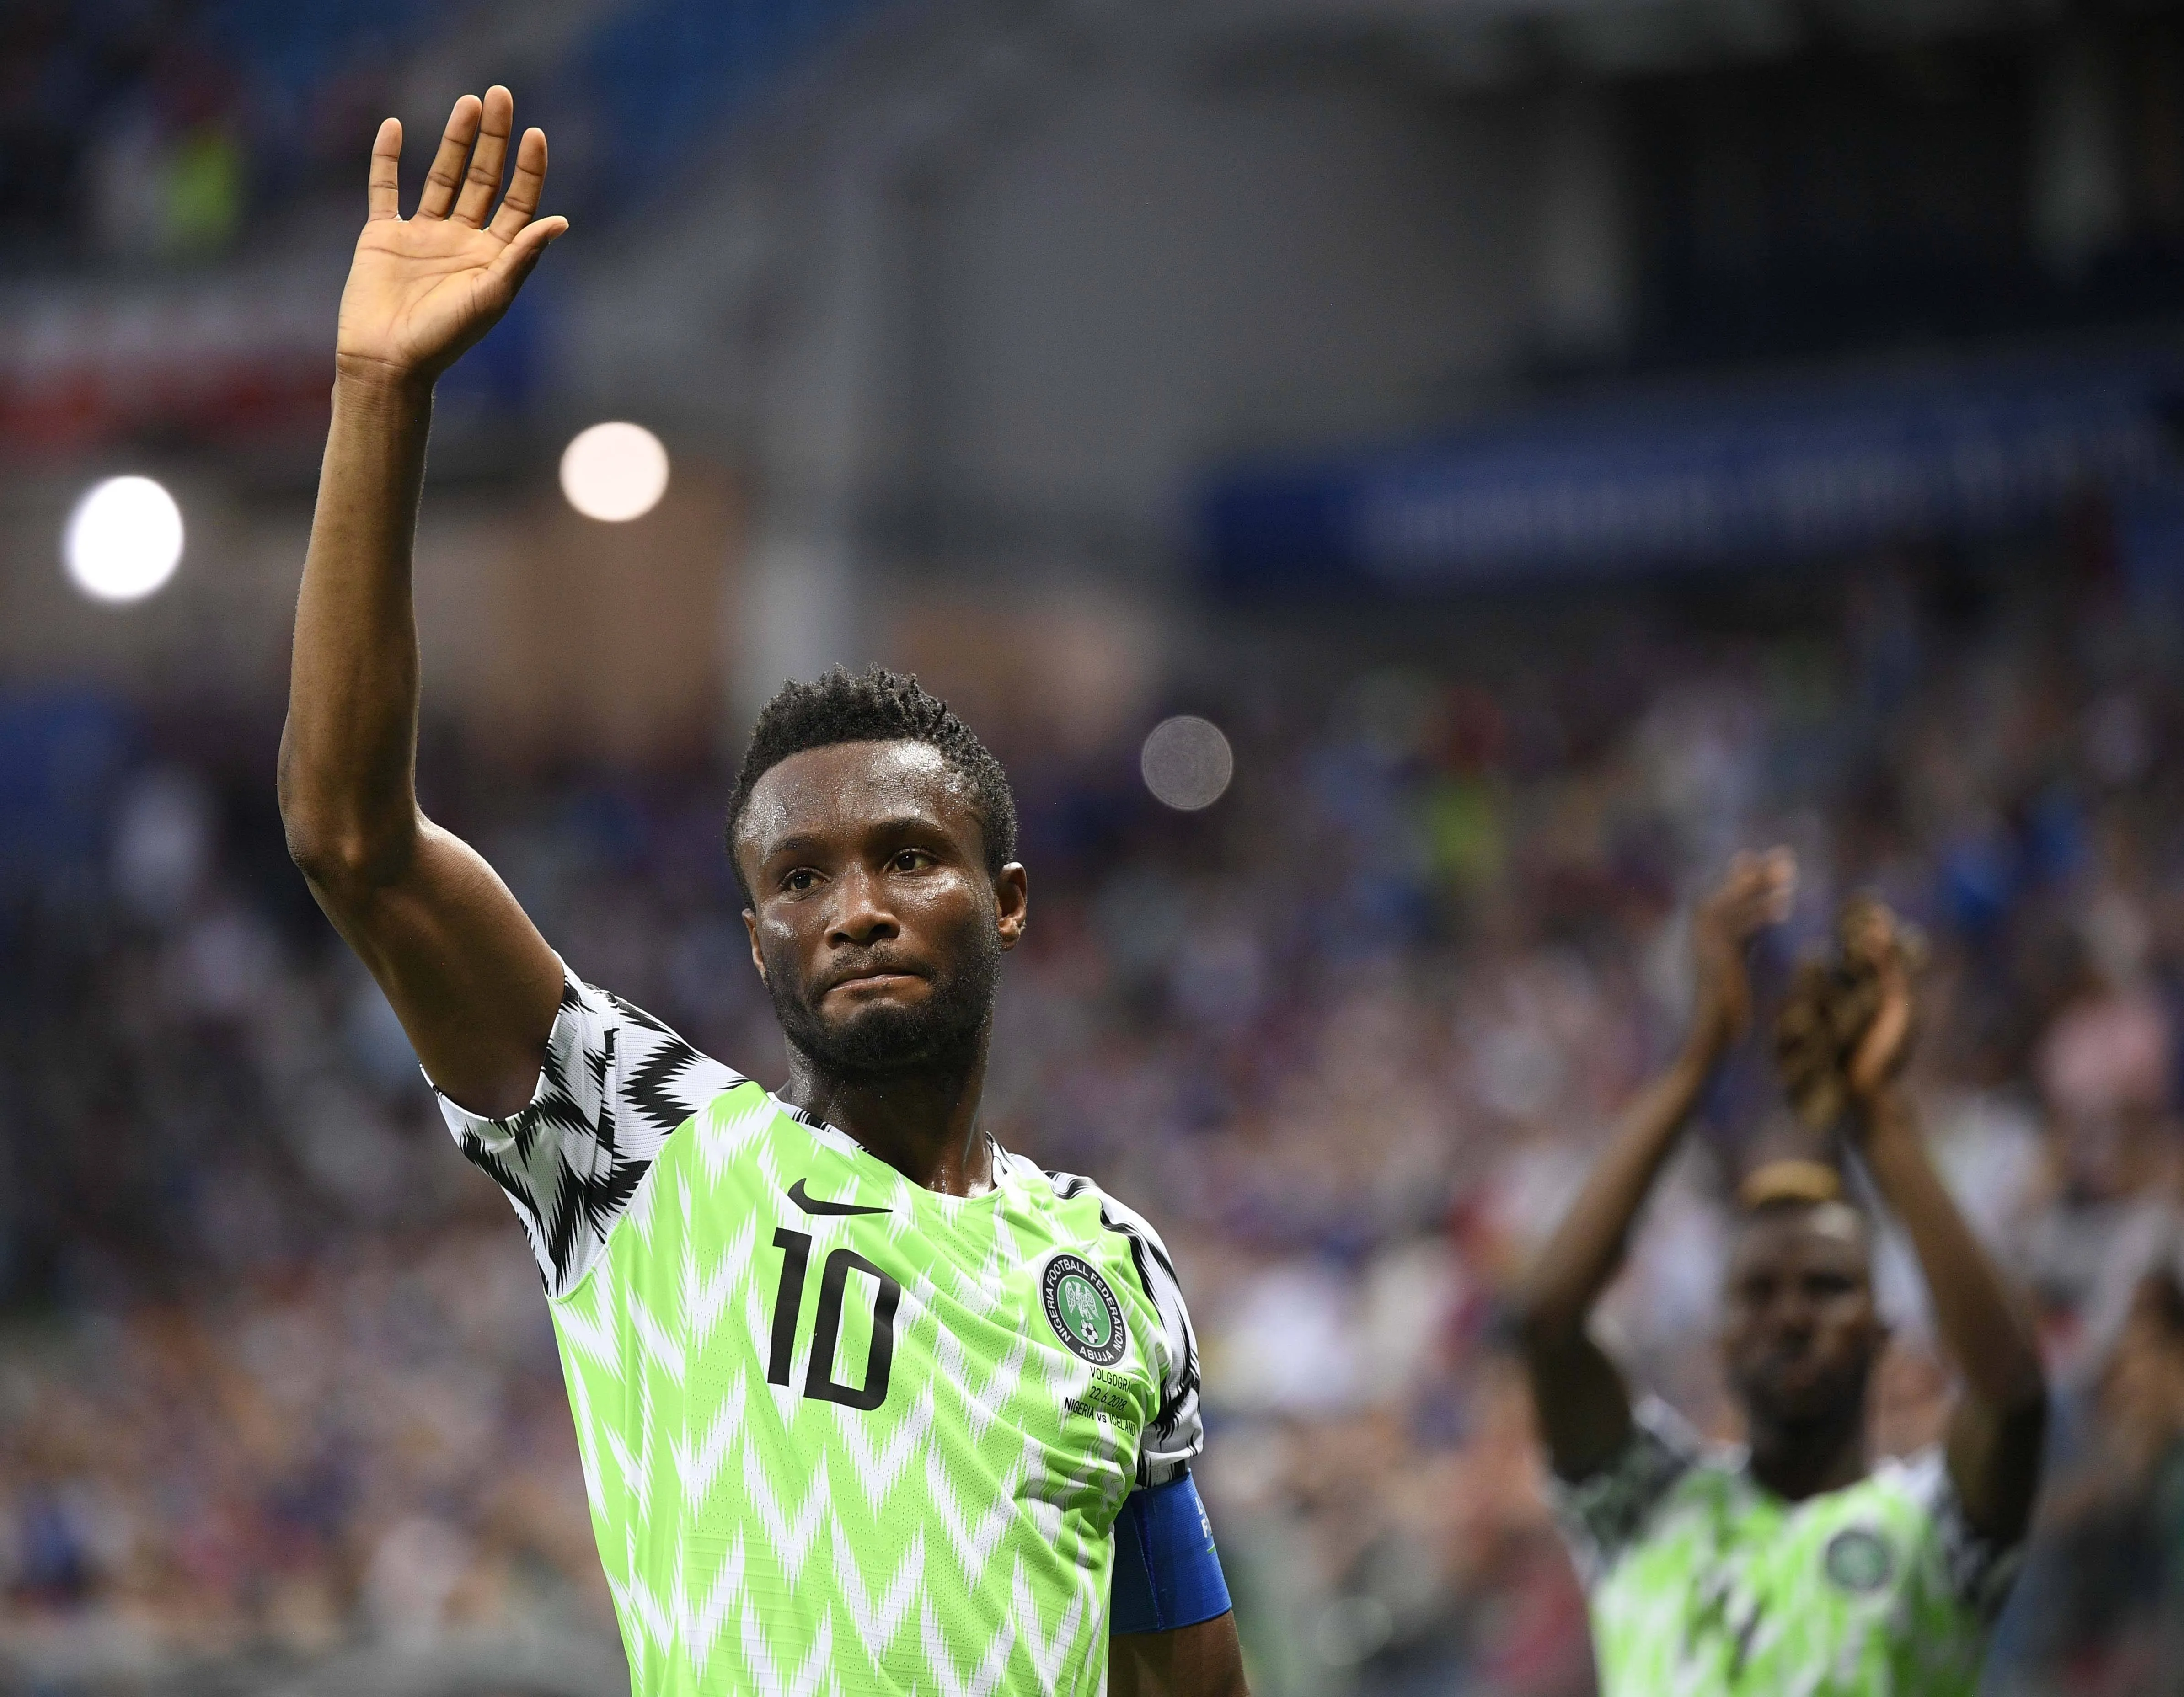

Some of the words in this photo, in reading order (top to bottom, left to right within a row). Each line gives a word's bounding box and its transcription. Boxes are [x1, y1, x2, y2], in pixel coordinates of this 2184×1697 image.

[1047, 1259, 1089, 1287] FOOTBALL
[767, 1227, 901, 1411] 10
[1045, 1287, 1071, 1343] NIGERIA
[1090, 1272, 1124, 1352] FEDERATION
[1079, 1346, 1115, 1362] ABUJA
[1064, 1397, 1094, 1420] NIGERIA
[1109, 1413, 1136, 1436] ICELAND
